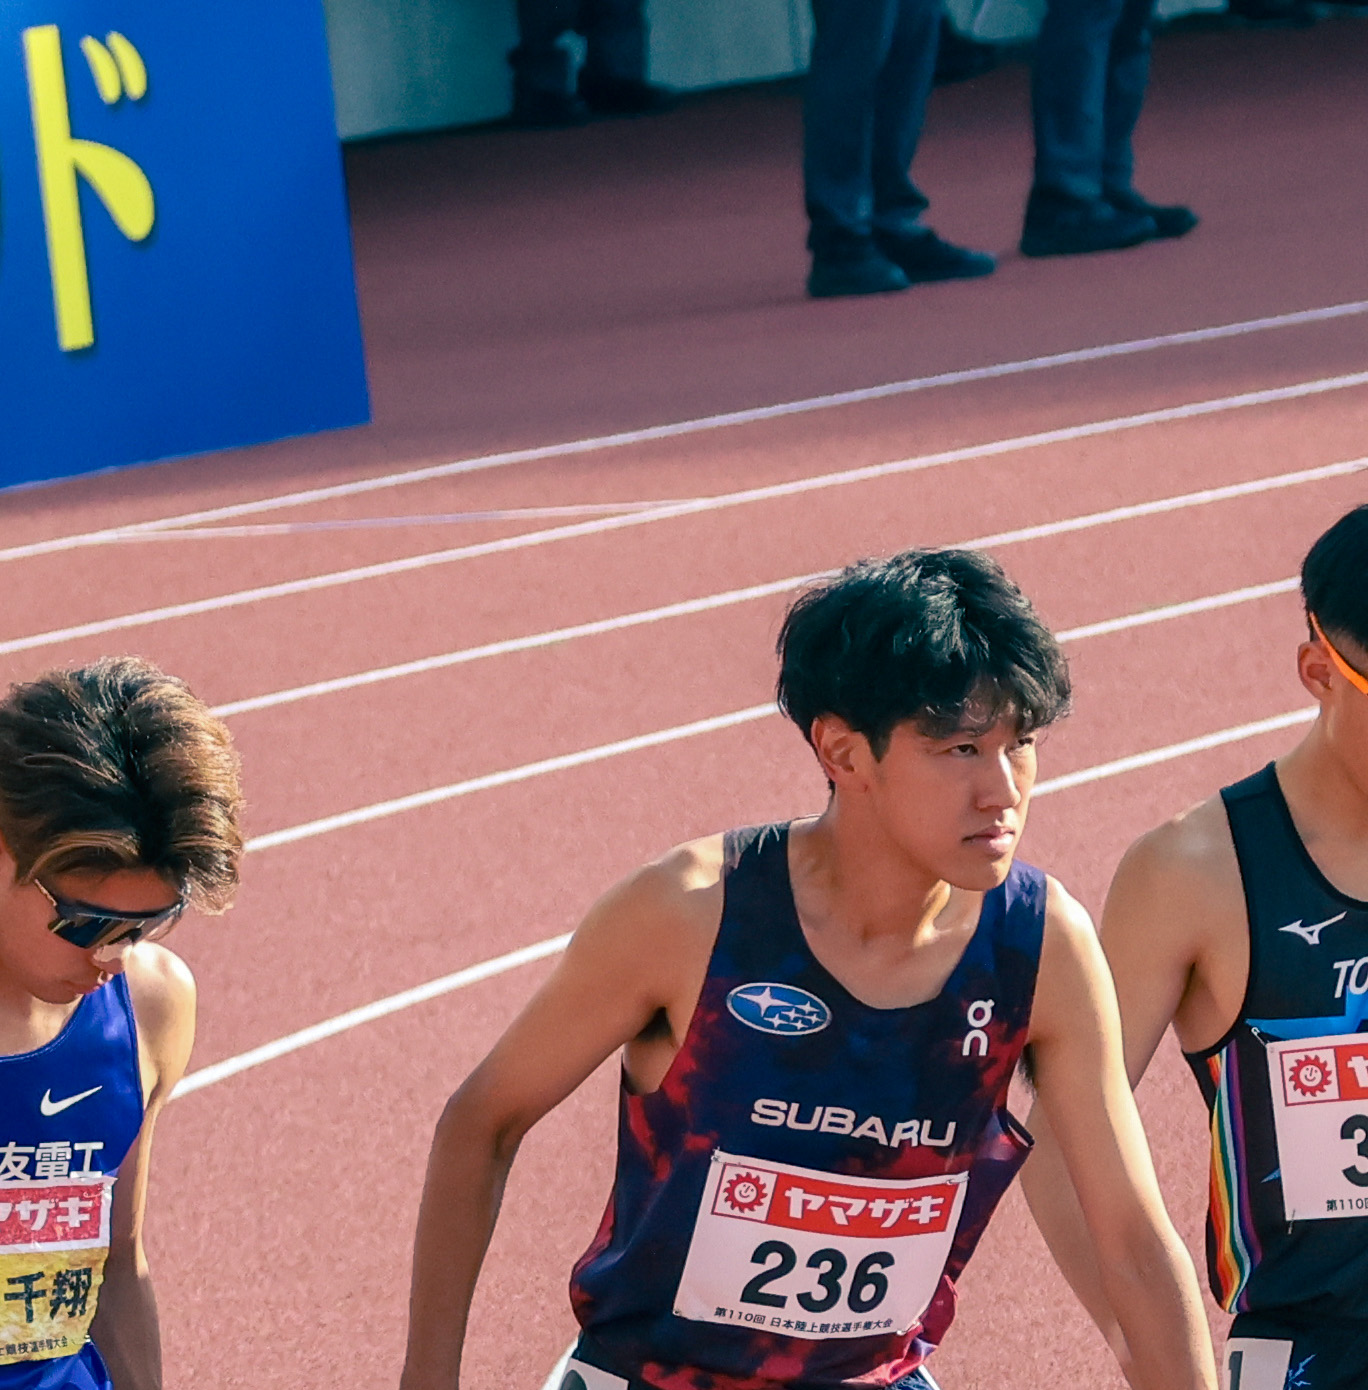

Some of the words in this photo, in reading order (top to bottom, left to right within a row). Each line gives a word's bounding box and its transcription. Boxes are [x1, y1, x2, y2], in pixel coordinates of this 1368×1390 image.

[750, 1097, 957, 1149] SUBARU
[784, 1186, 945, 1229] ヤマザキ
[3, 1266, 93, 1325] 千翔
[739, 1239, 896, 1315] 236
[713, 1305, 767, 1326] 第110回
[769, 1316, 894, 1335] 日本陸上競技選手権大会
